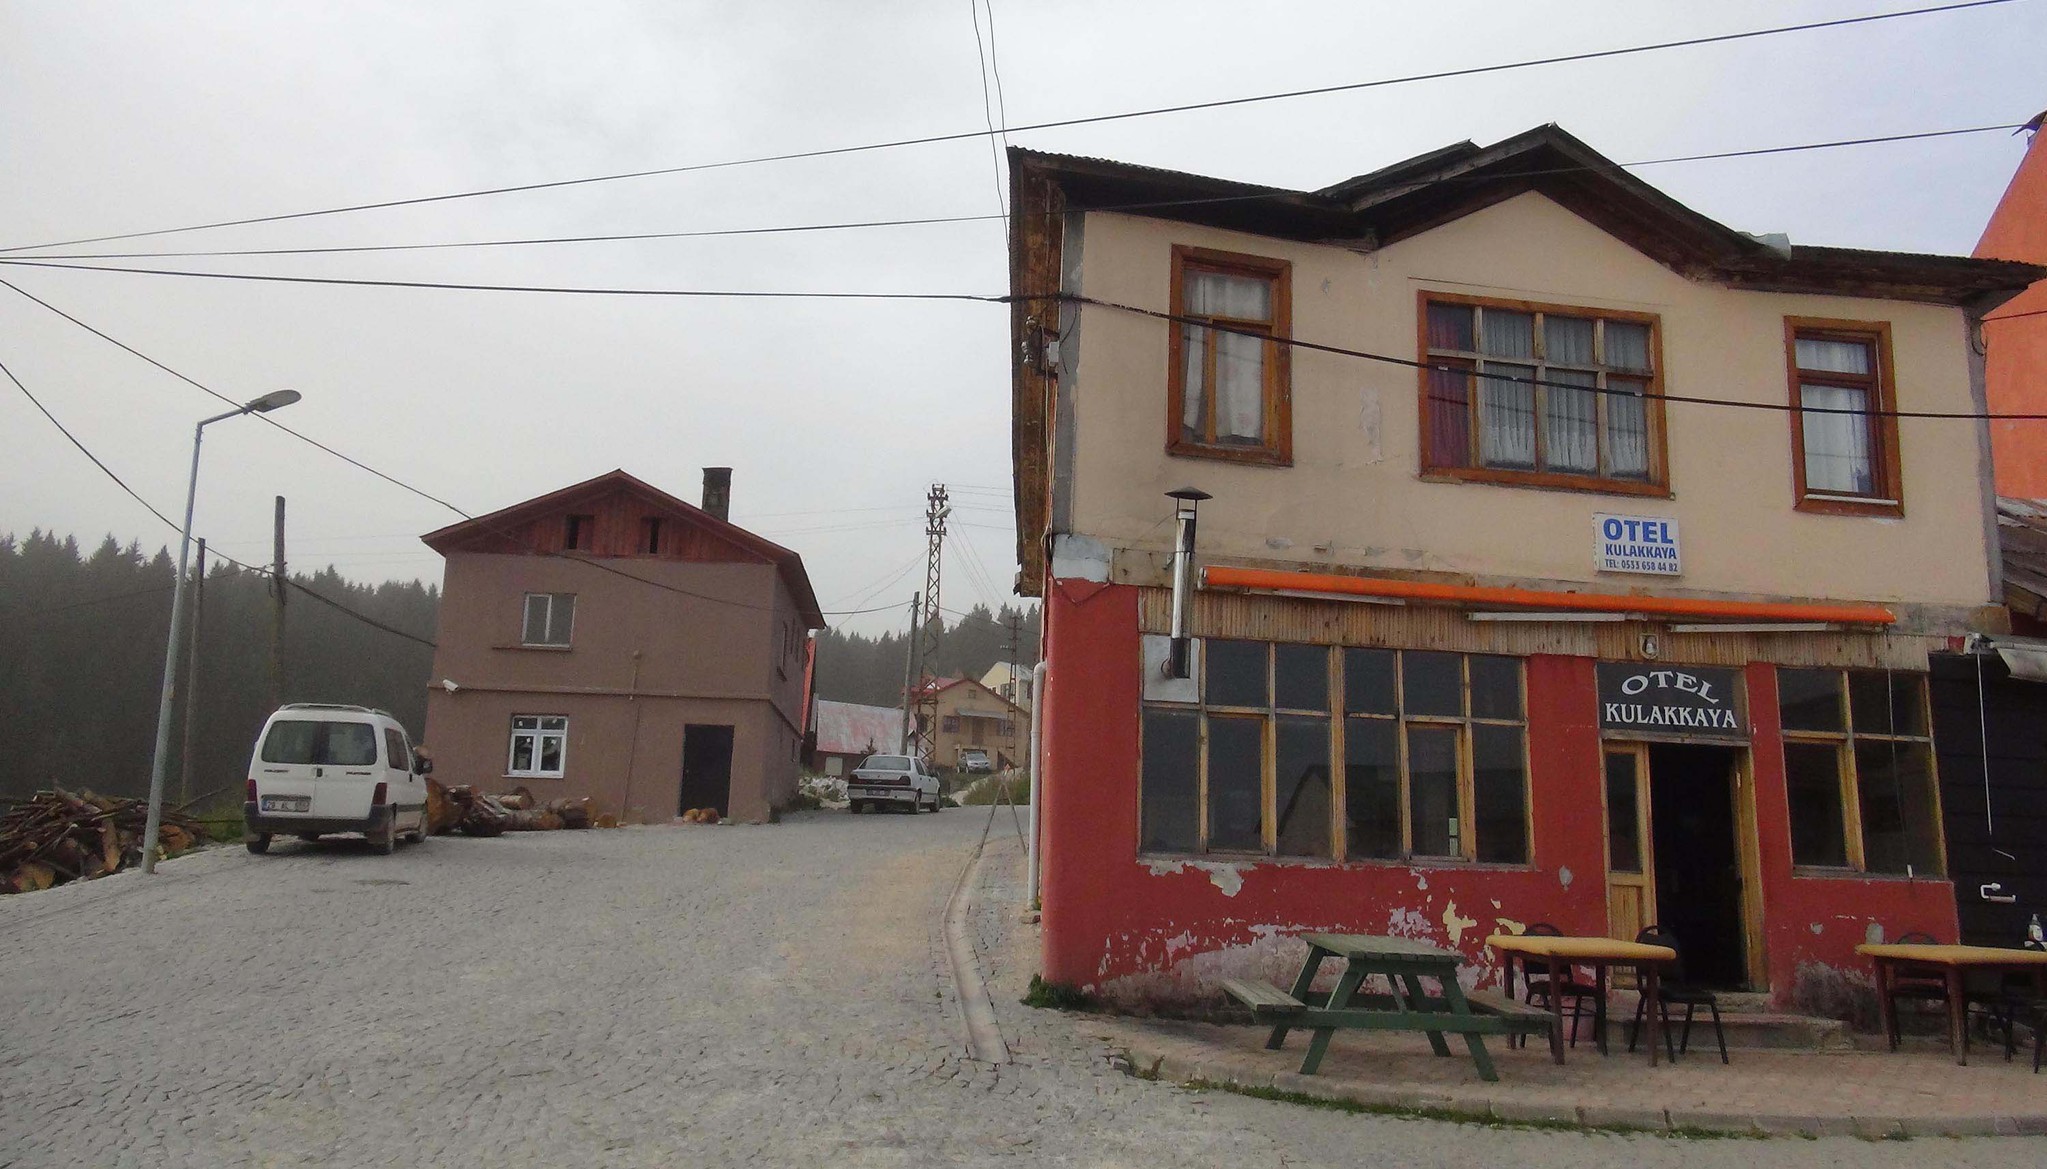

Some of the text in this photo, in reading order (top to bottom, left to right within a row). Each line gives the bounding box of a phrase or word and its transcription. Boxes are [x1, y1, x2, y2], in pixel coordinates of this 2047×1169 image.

[1603, 518, 1674, 544] OTEL
[1605, 543, 1677, 560] KULAKKAYA
[1621, 559, 1640, 570] 0533
[1641, 561, 1656, 571] 658
[1658, 562, 1667, 572] 44
[1668, 562, 1678, 572] 82
[1621, 670, 1719, 705] OTEL
[1605, 702, 1738, 728] KULAKKAYA
